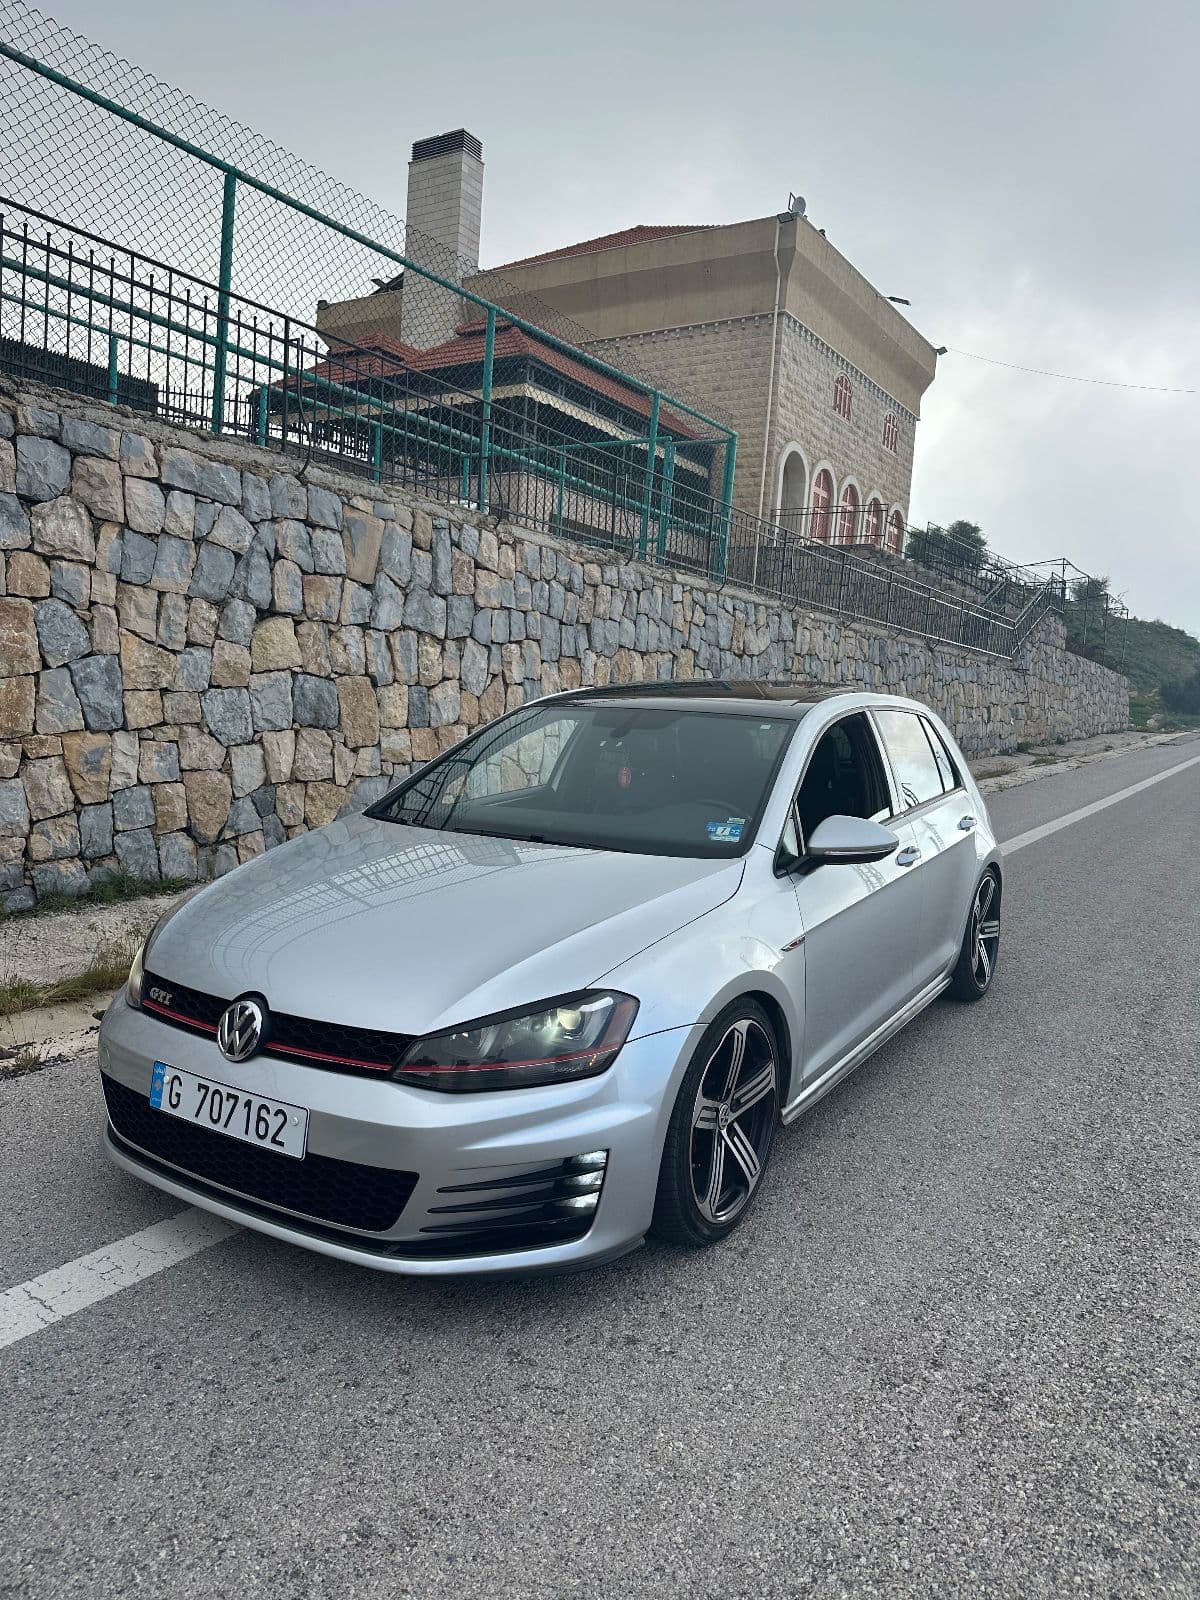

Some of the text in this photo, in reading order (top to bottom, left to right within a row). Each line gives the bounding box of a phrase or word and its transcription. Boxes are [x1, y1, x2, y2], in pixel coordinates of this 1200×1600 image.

[150, 987, 172, 1006] GTI
[169, 1074, 288, 1147] G 707162
